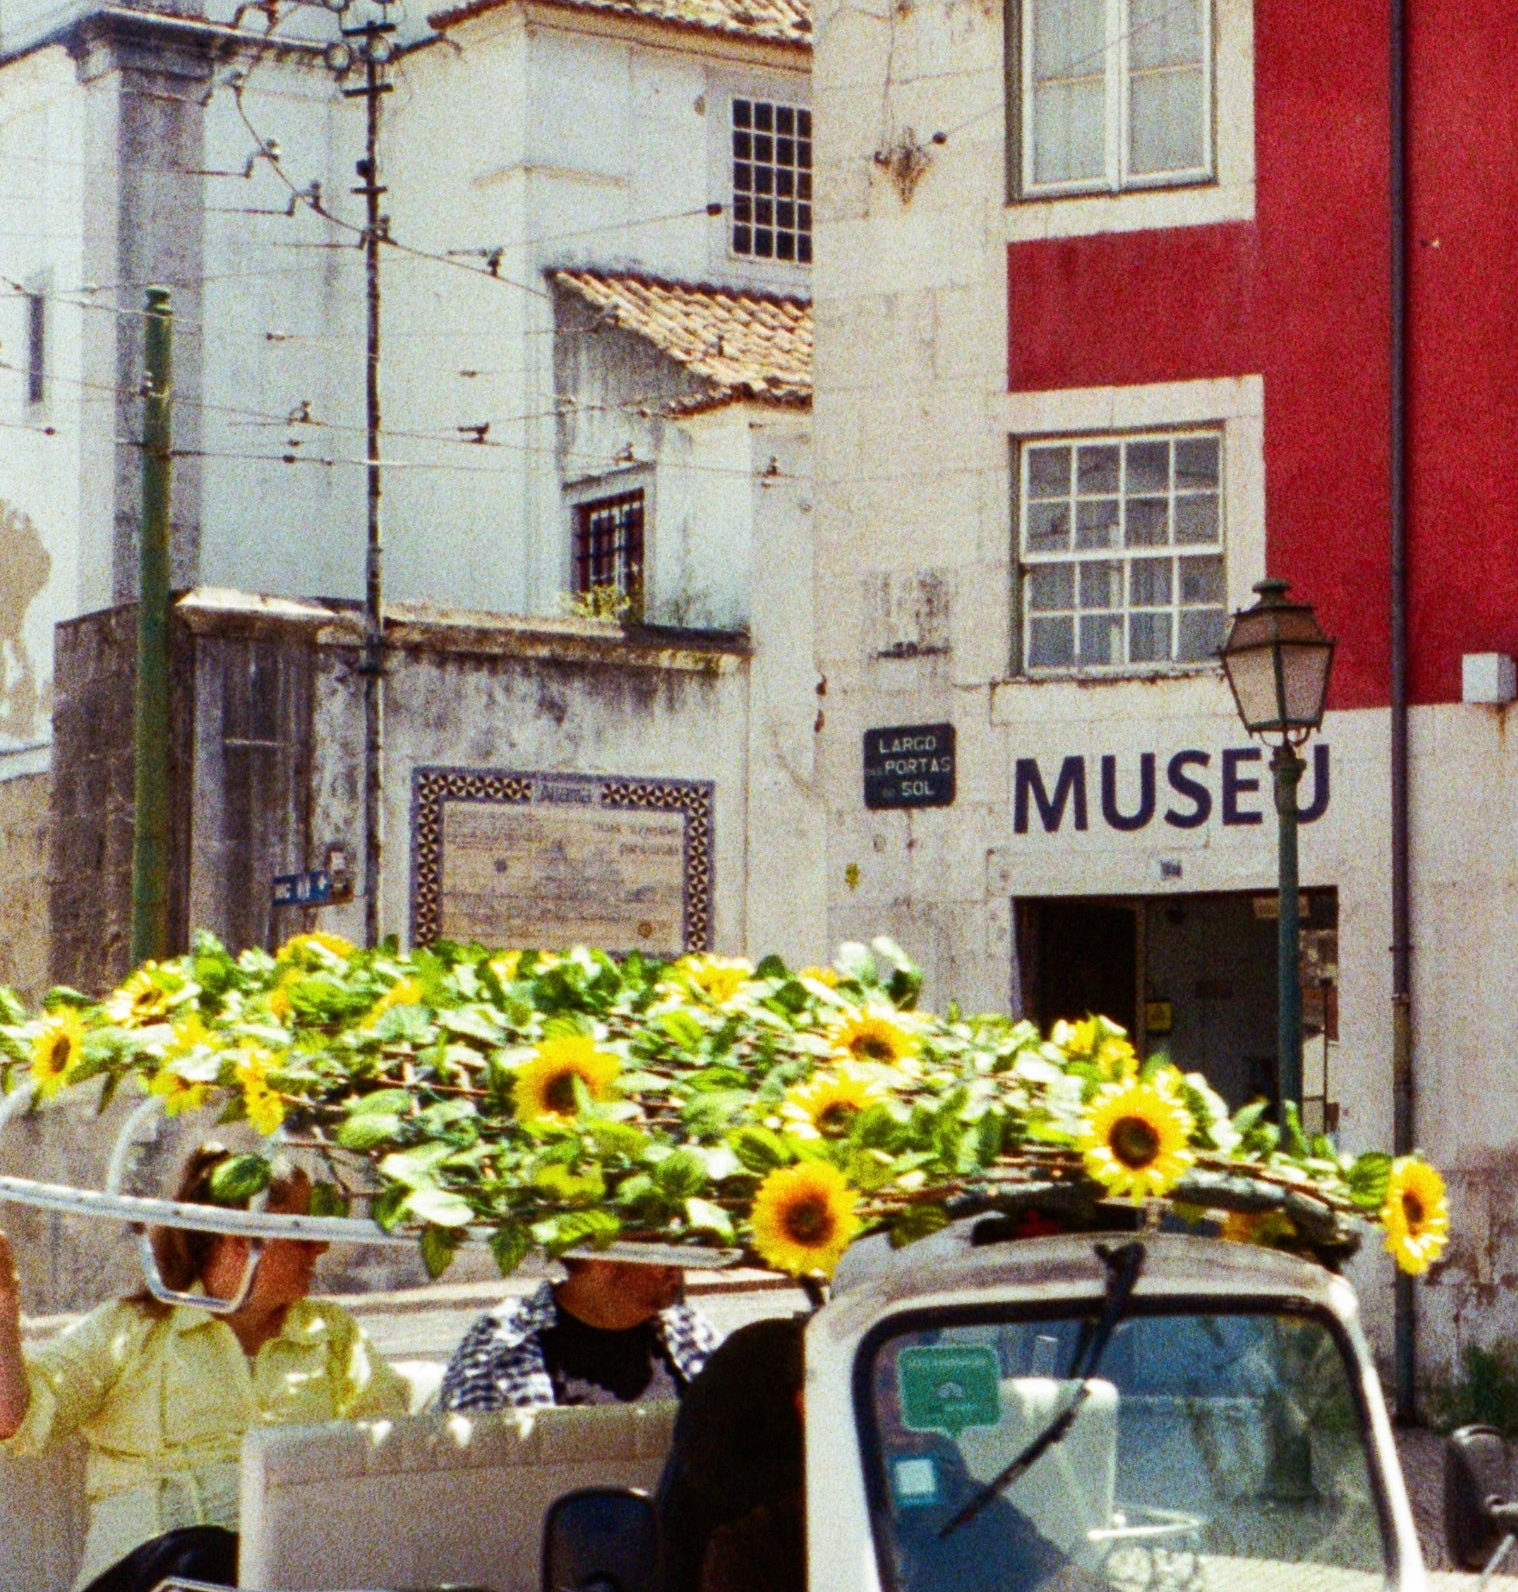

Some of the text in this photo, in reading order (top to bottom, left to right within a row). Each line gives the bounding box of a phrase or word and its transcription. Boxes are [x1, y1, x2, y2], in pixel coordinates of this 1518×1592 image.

[878, 735, 937, 754] LARGO
[884, 755, 952, 776] PORTAS
[900, 780, 936, 798] SOL
